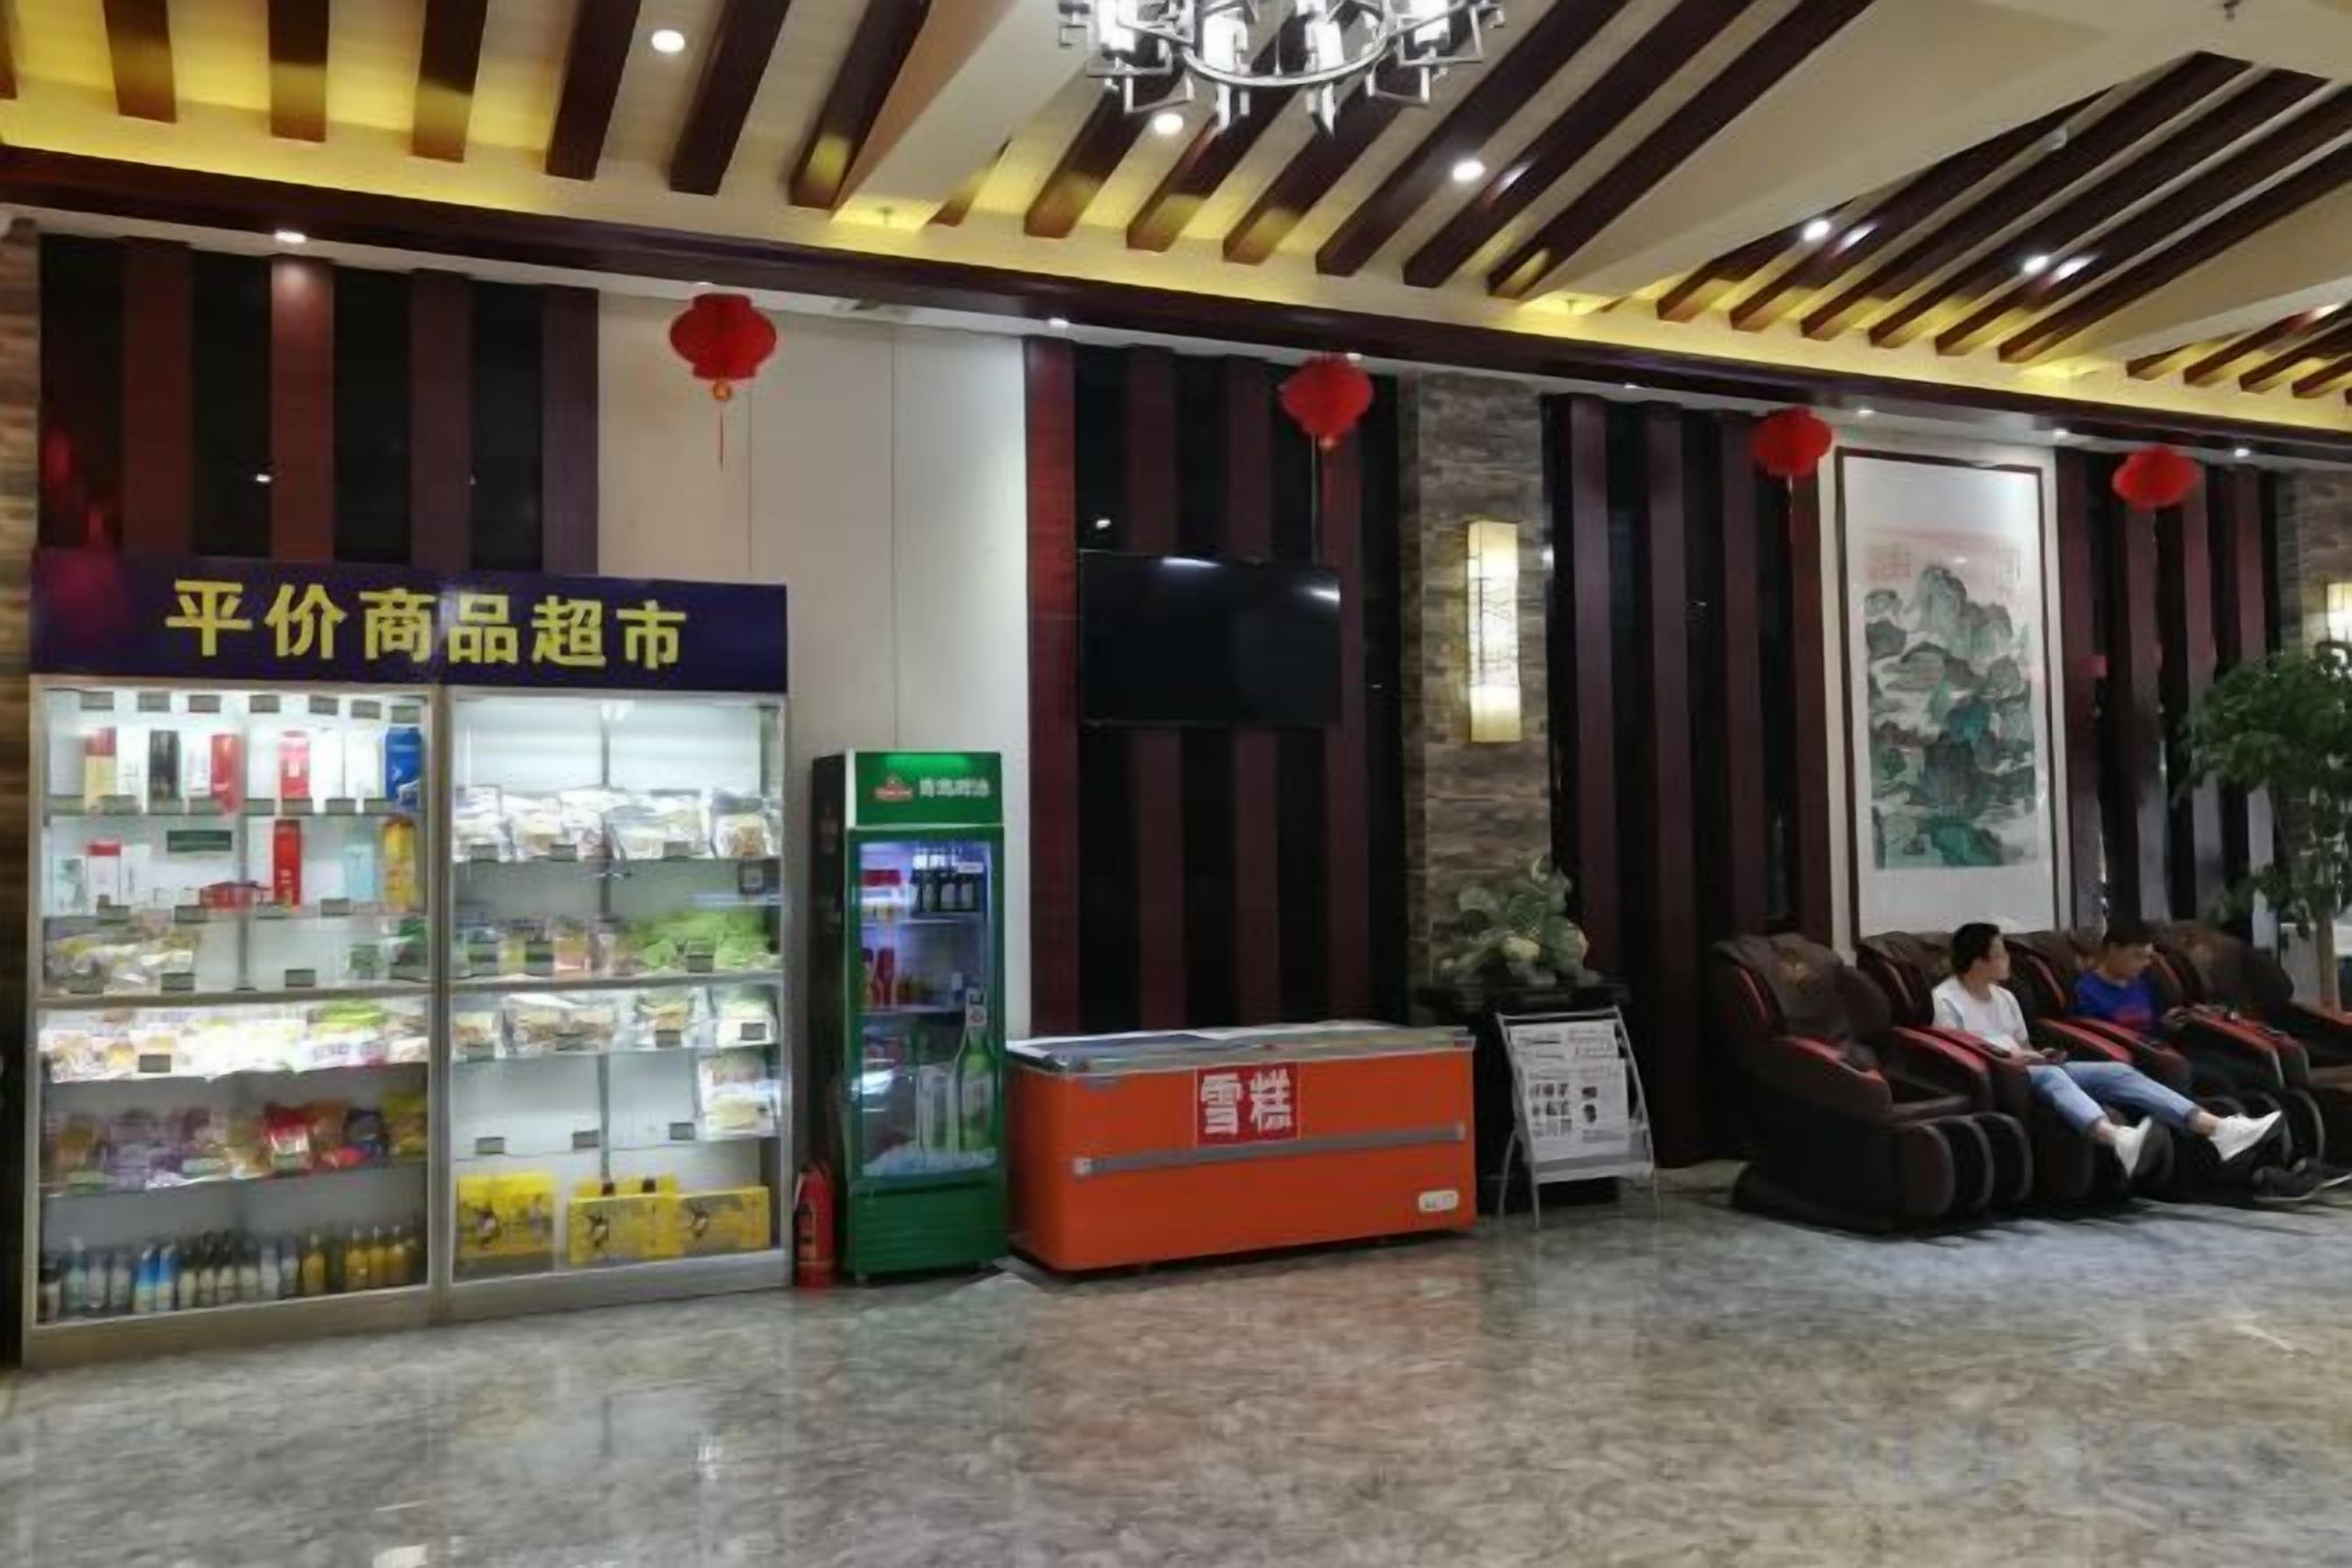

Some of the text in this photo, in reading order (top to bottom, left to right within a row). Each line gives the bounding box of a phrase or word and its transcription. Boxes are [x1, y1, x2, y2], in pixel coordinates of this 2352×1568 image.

[166, 580, 686, 669] 平价商品超市
[1201, 1069, 1291, 1134] 雪糕
